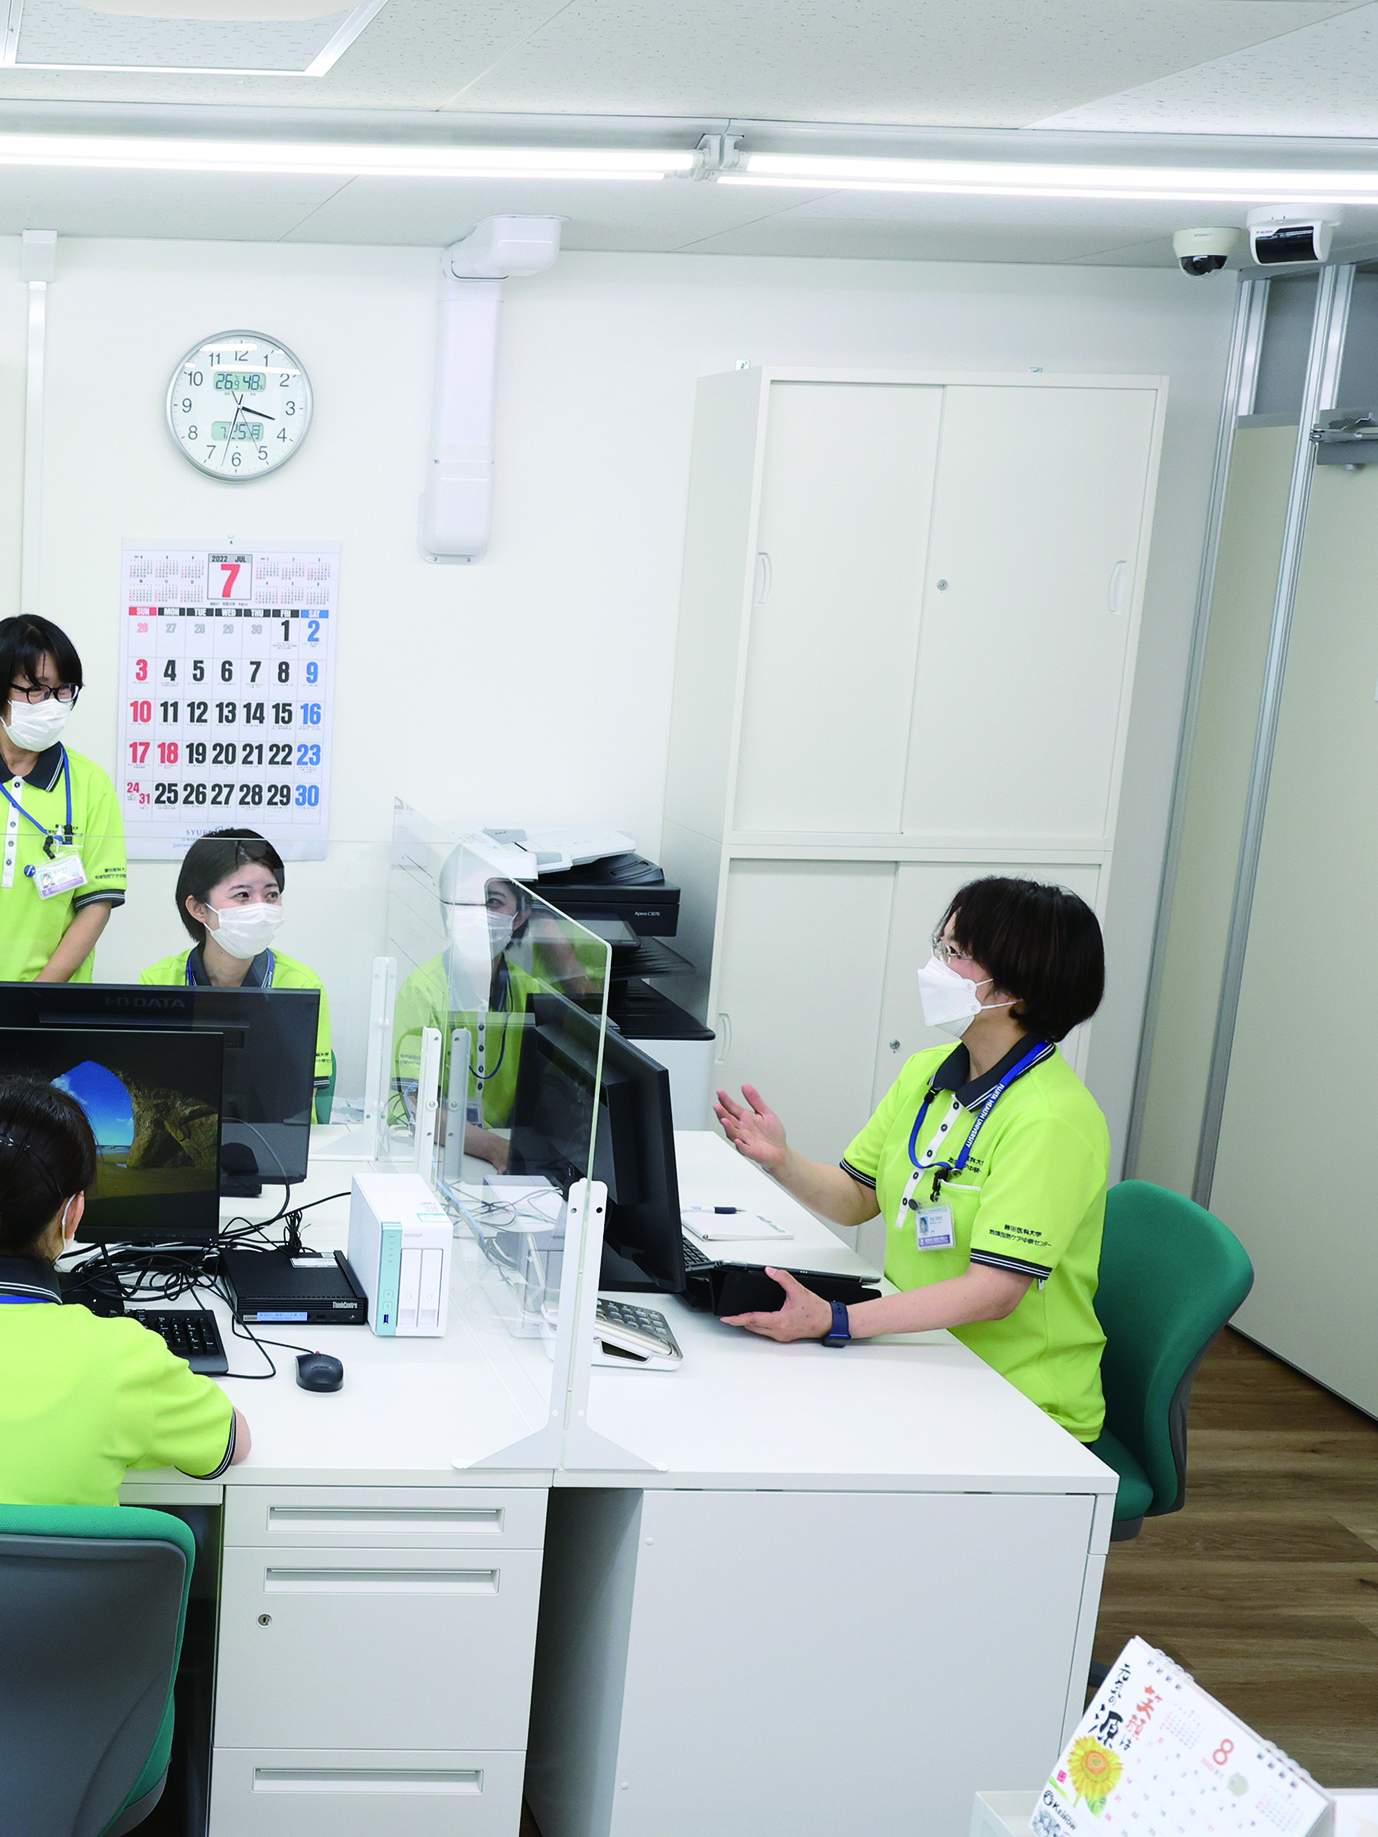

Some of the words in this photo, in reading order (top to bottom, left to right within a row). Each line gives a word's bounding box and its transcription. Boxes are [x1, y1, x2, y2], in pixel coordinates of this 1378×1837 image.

[209, 352, 221, 367] 11
[263, 354, 269, 367] 1
[187, 371, 204, 387] 10
[279, 373, 290, 388] 2
[182, 398, 193, 413] 9
[285, 400, 296, 416] 3
[187, 425, 198, 441] 8
[276, 427, 288, 443] 4
[206, 444, 217, 460] 7
[231, 451, 242, 467] 6
[257, 445, 268, 461] 5
[211, 555, 228, 563] 2022
[220, 563, 241, 598] 7
[135, 607, 150, 616] SUN
[163, 608, 180, 616] MON
[194, 608, 207, 617] TUE
[221, 609, 237, 617] WED
[250, 609, 264, 617] THU
[280, 609, 291, 618] FRI
[308, 610, 321, 618] SAT
[137, 622, 149, 633] 26
[165, 623, 177, 633] 27
[281, 619, 290, 642] 1
[307, 619, 320, 642] 2
[135, 658, 148, 681] 3
[163, 659, 177, 682] 4
[192, 659, 205, 682] 5
[220, 660, 233, 682] 6
[249, 660, 262, 683] 7
[277, 661, 290, 683] 8
[306, 661, 319, 684] 9
[130, 700, 152, 723] 10
[159, 701, 179, 723] 11
[186, 701, 208, 723] 12
[215, 702, 237, 724] 13
[243, 702, 265, 725] 14
[271, 702, 293, 725] 15
[300, 702, 322, 725] 16
[129, 741, 151, 764] 17
[157, 741, 179, 764] 18
[185, 742, 207, 764] 19
[211, 742, 237, 765] 20
[241, 743, 264, 765] 21
[268, 743, 293, 766] 22
[296, 743, 322, 766] 23
[126, 781, 140, 794] 24
[154, 782, 179, 805] 25
[182, 782, 207, 805] 26
[210, 783, 236, 806] 27
[238, 783, 263, 806] 28
[267, 784, 292, 806] 29
[295, 784, 320, 807] 30
[138, 792, 151, 805] 31
[1212, 1738, 1235, 1766] 8
